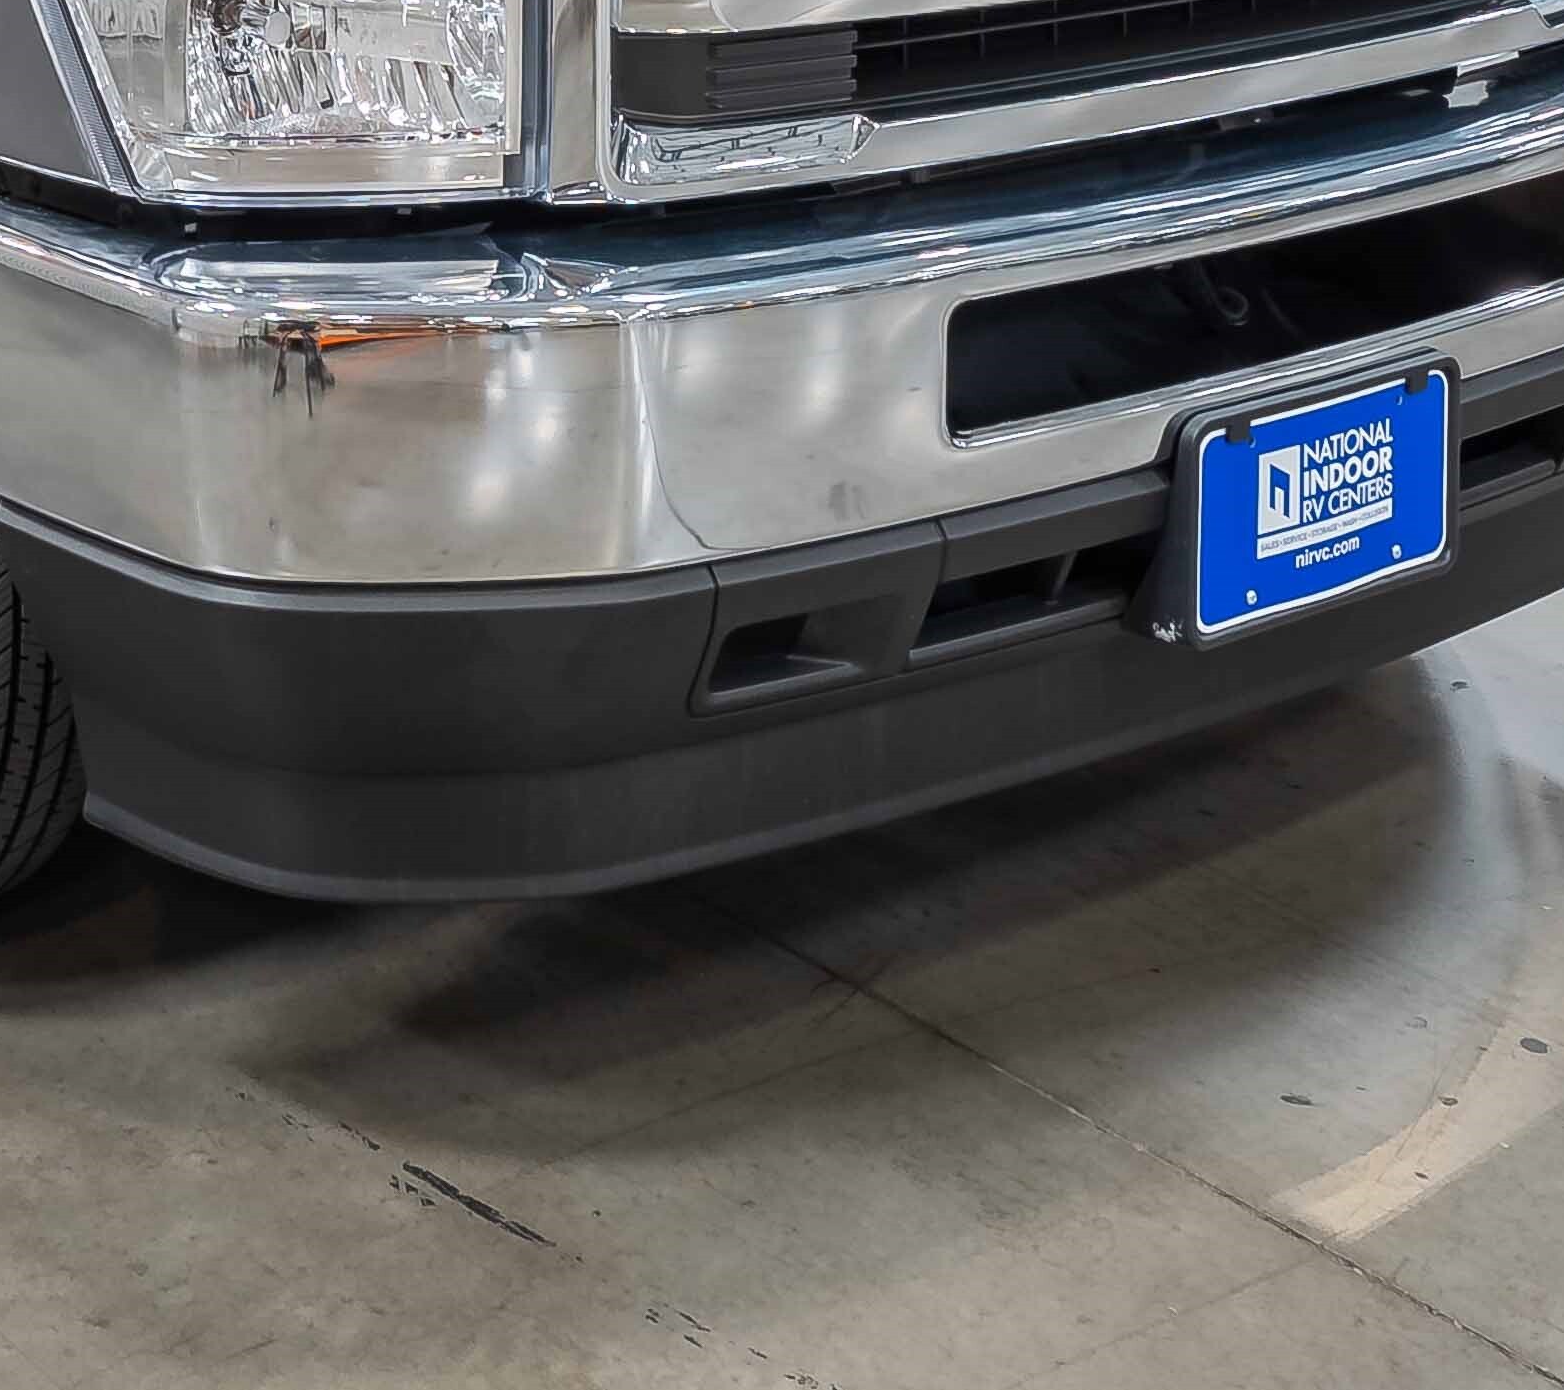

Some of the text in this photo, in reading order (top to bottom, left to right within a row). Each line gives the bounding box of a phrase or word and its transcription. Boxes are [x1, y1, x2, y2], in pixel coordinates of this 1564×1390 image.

[1303, 417, 1394, 468] NATIONAL
[1303, 446, 1393, 498] INDOOR
[1303, 473, 1393, 524] RV CENTERS
[1295, 536, 1360, 568] nirvc.com
